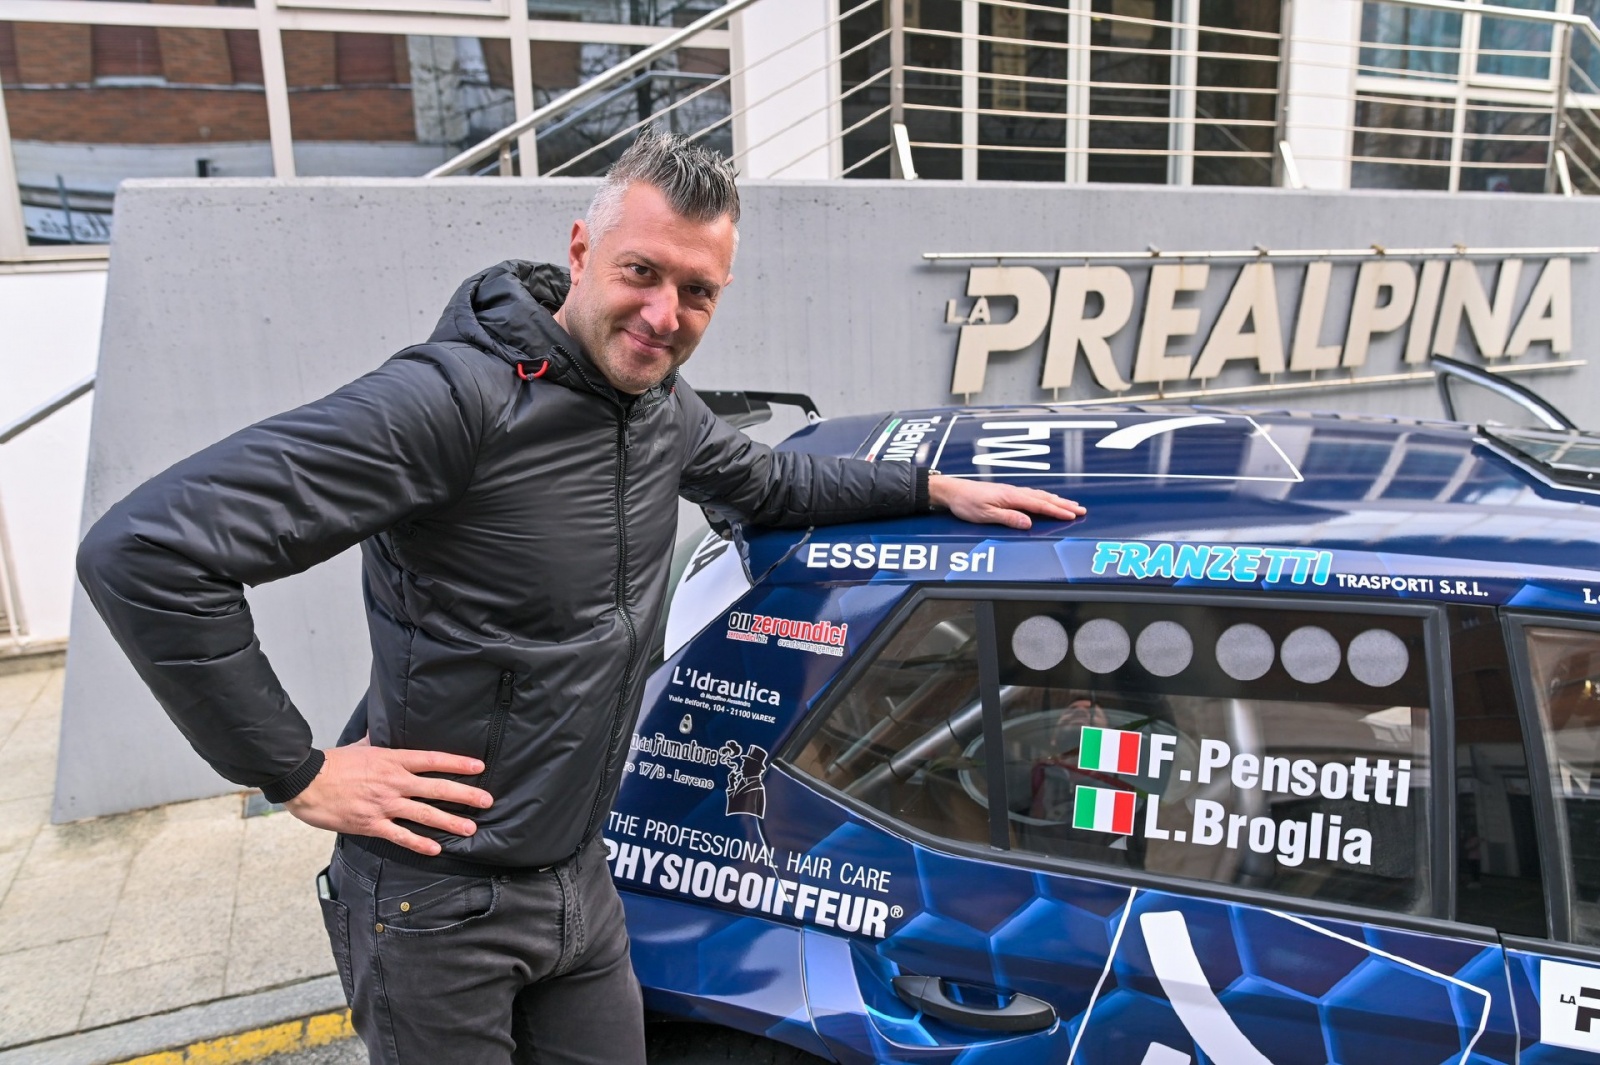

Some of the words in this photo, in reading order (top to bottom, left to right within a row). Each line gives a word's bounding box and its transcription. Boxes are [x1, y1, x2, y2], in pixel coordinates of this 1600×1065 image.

[947, 296, 991, 325] LA
[951, 258, 1572, 394] PREALPINA
[807, 543, 938, 571] ESSEBI
[949, 547, 995, 573] srl
[1091, 541, 1334, 586] FRANZETTI
[1336, 573, 1435, 594] TRASPORTI
[1439, 580, 1489, 597] S.R.L.
[1582, 588, 1600, 605] L
[672, 666, 780, 706] L'Idraulica
[668, 694, 683, 704] Viale
[684, 697, 711, 711] Belforte,
[713, 704, 725, 713] 104
[730, 707, 751, 719] 21100
[751, 712, 776, 723] VARESE
[640, 737, 653, 753] del
[651, 732, 718, 767] Fumatore
[639, 761, 665, 780] 17/B
[673, 769, 715, 790] Laveno
[1147, 733, 1412, 808] F.Pensotti
[1144, 793, 1373, 868] L.Broglia
[608, 811, 640, 837] THE
[643, 819, 777, 867] PROFESSIONAL
[786, 851, 832, 879] HAIR
[839, 863, 892, 893] CARE
[1559, 993, 1577, 1006] LA
